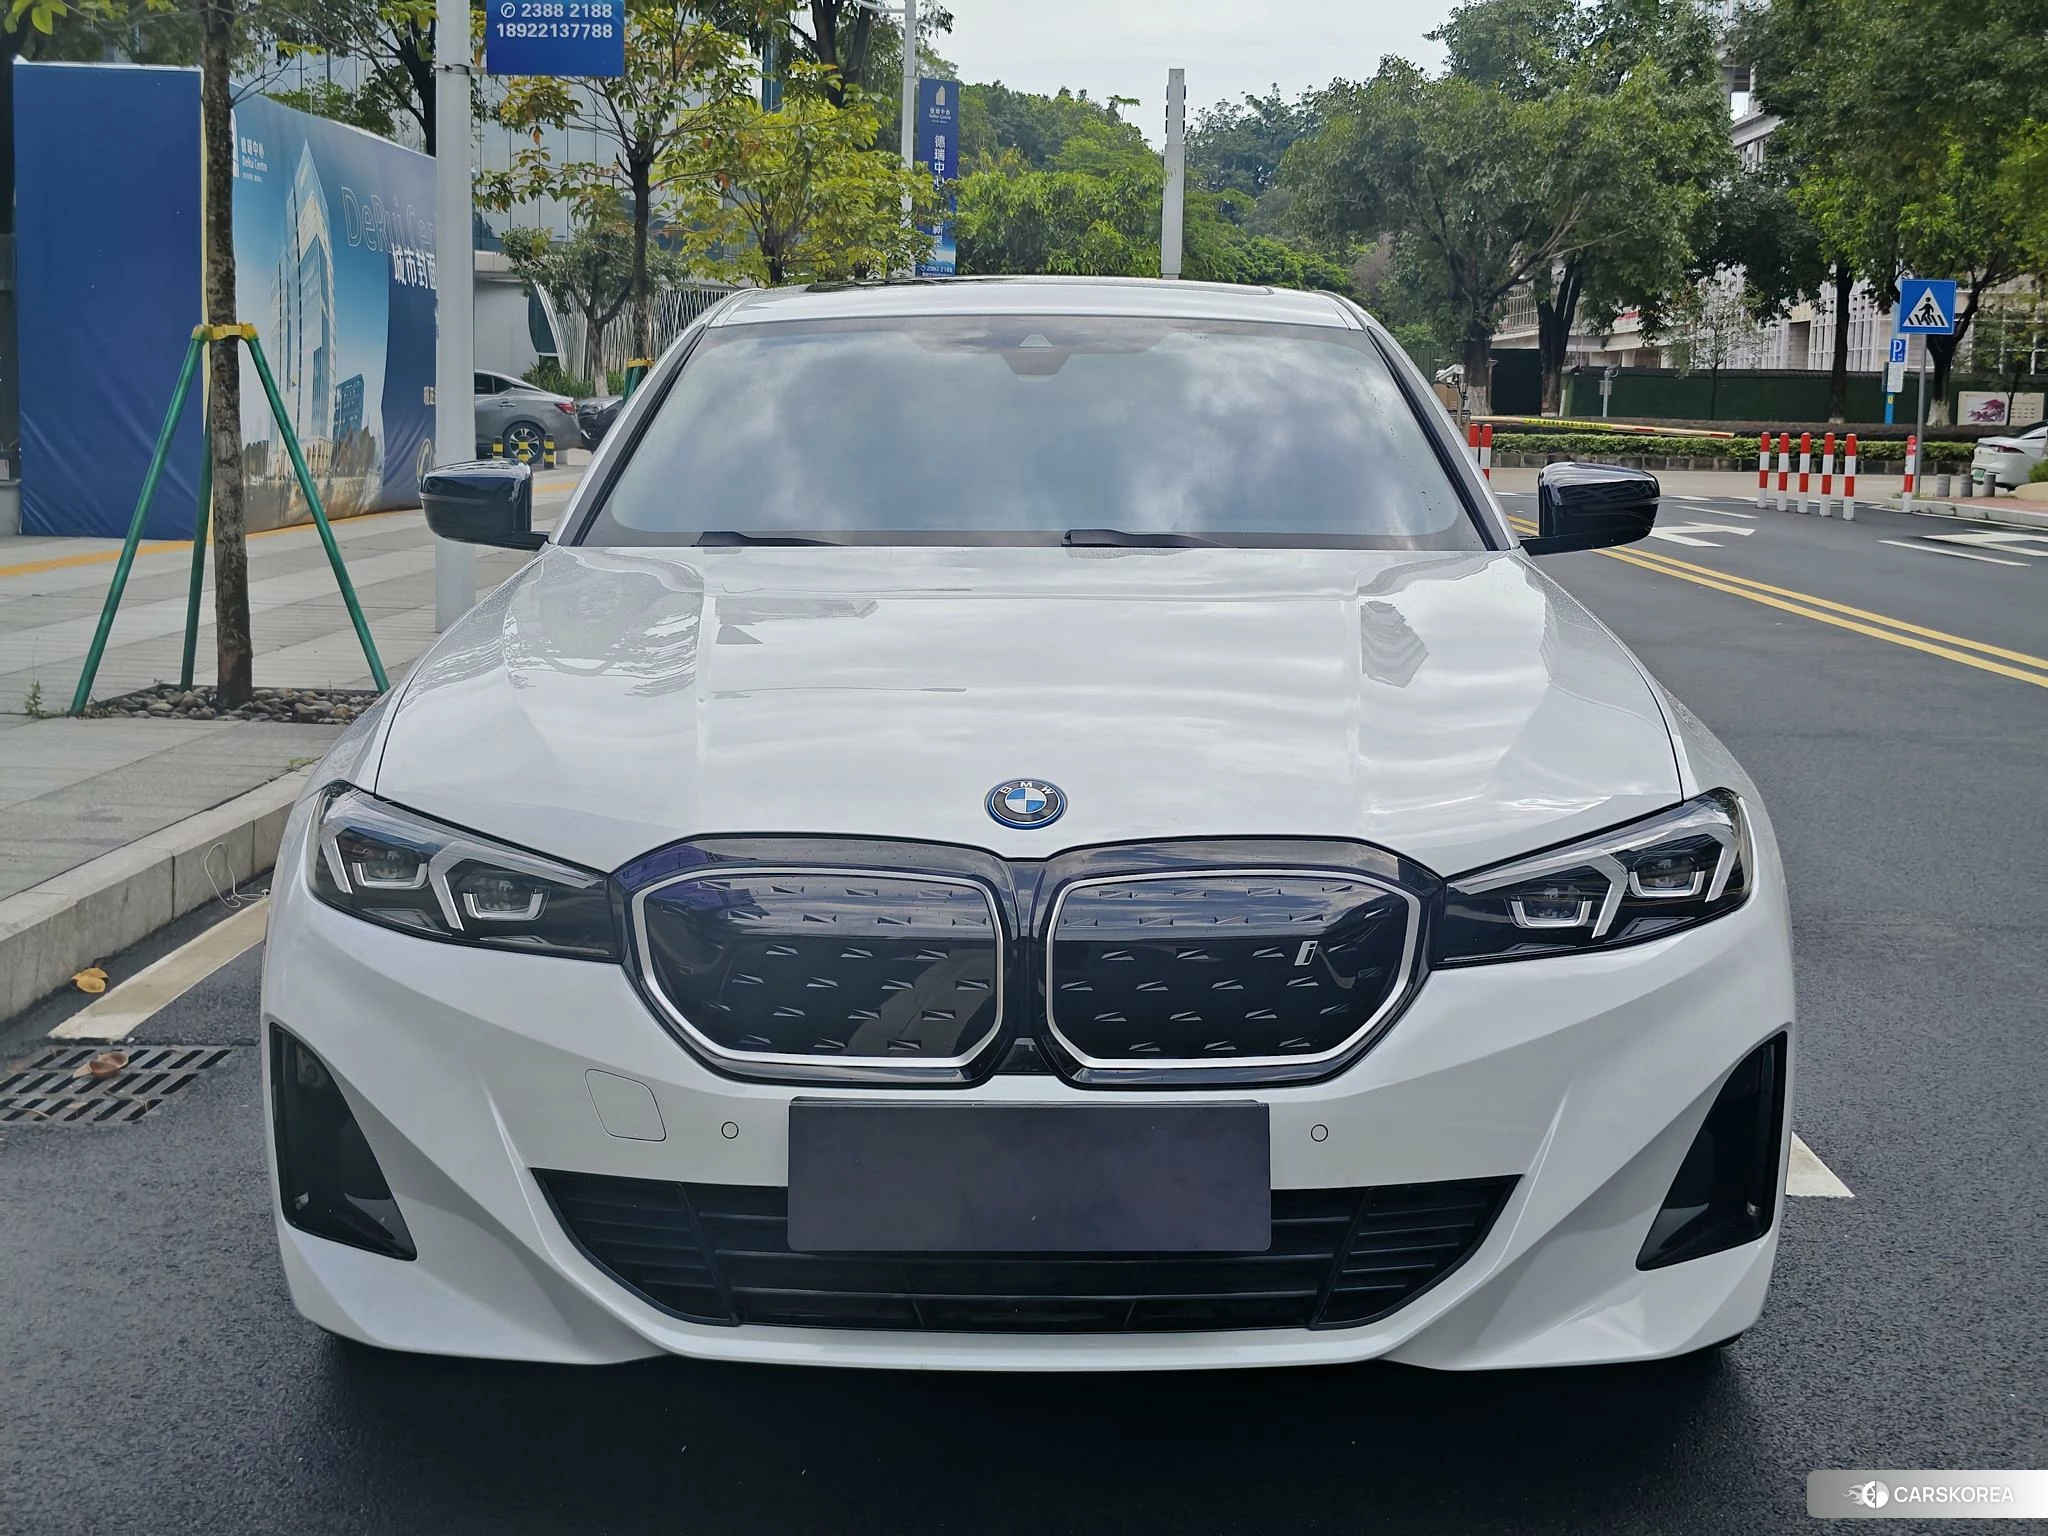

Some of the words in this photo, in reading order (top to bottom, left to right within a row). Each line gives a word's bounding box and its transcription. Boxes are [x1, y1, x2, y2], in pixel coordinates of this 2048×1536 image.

[521, 3, 564, 18] 2388
[569, 4, 613, 18] 2188
[496, 23, 613, 39] 18922137788
[341, 187, 405, 253] DeRui
[999, 781, 1055, 794] BMW
